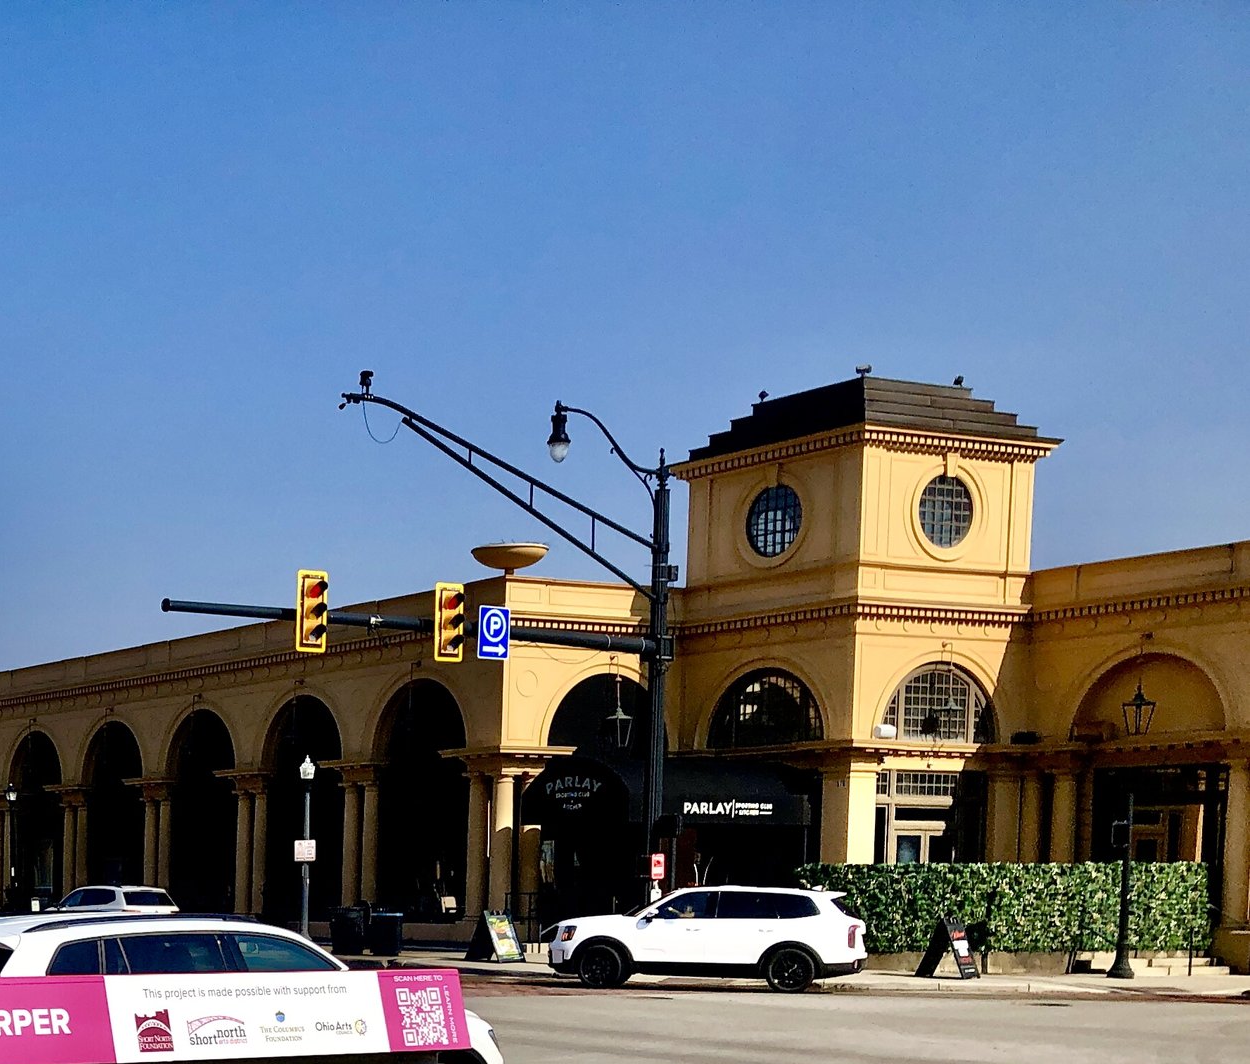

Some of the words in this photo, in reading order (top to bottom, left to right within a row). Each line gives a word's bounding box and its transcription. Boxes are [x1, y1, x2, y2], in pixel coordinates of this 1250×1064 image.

[490, 616, 501, 636] P
[545, 775, 602, 795] PARLAY
[683, 801, 732, 815] PARLAY
[143, 988, 162, 998] This
[165, 988, 196, 1000] project
[198, 988, 206, 997] is
[208, 987, 233, 997] made
[235, 986, 271, 998] possible
[273, 986, 291, 995] with
[293, 986, 326, 996] support
[327, 984, 347, 994] from
[443, 985, 453, 1016] LEARN
[449, 1017, 458, 1043] MORE
[189, 1033, 218, 1045] short
[216, 1025, 247, 1038] north
[315, 1021, 335, 1031] Ohio
[335, 1021, 352, 1031] Arts
